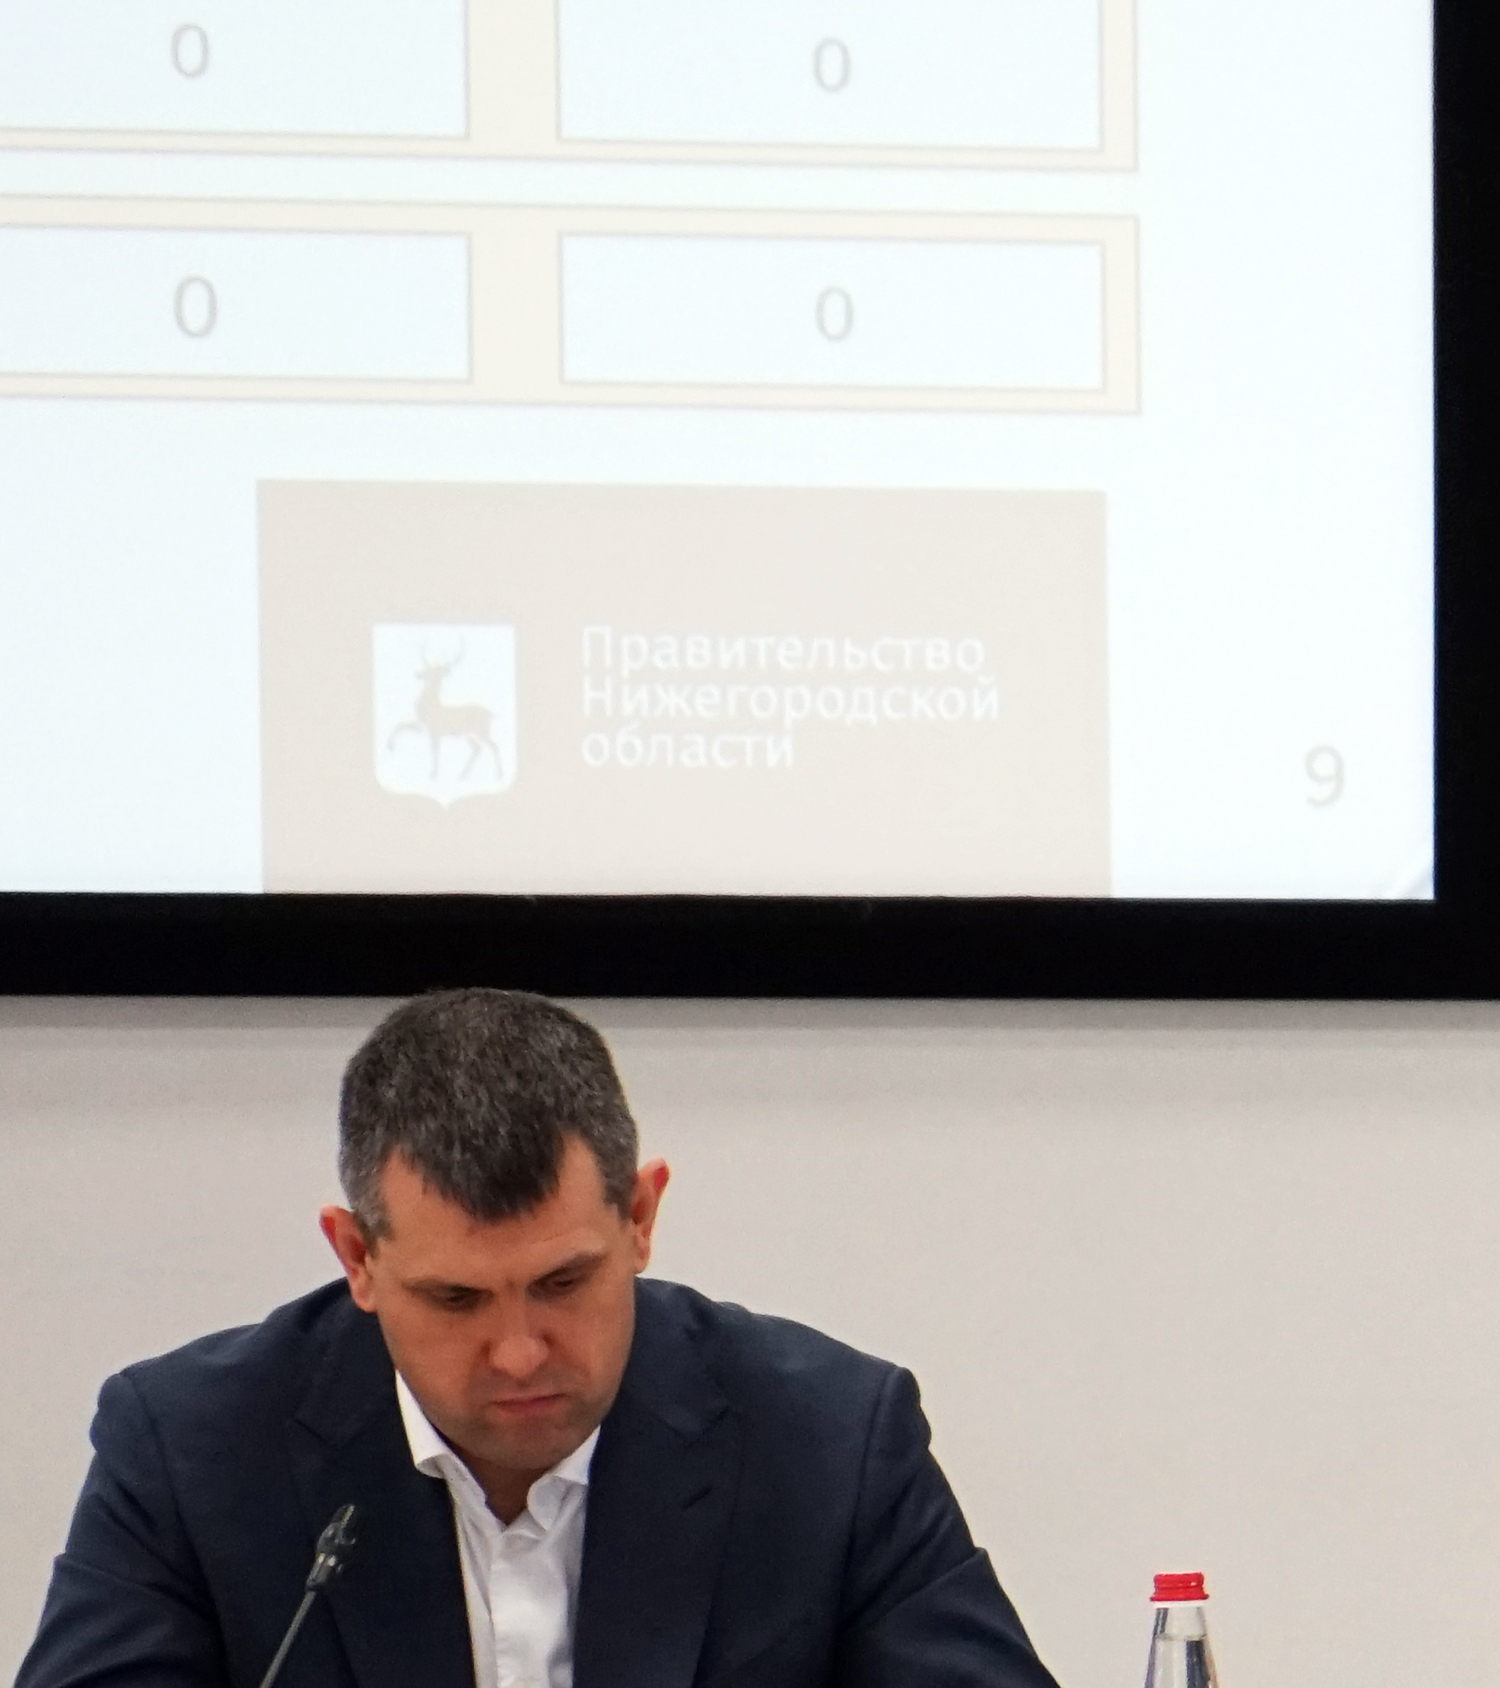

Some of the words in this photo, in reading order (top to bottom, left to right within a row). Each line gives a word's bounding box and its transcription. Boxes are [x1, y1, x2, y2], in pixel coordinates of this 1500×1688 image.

[168, 21, 211, 80] 0
[810, 36, 852, 93] 0
[172, 275, 219, 338] 0
[814, 284, 855, 341] 0
[581, 625, 988, 678] Правительство
[581, 674, 999, 729] Нижегородской
[581, 722, 796, 768] области
[1302, 745, 1347, 806] 9
